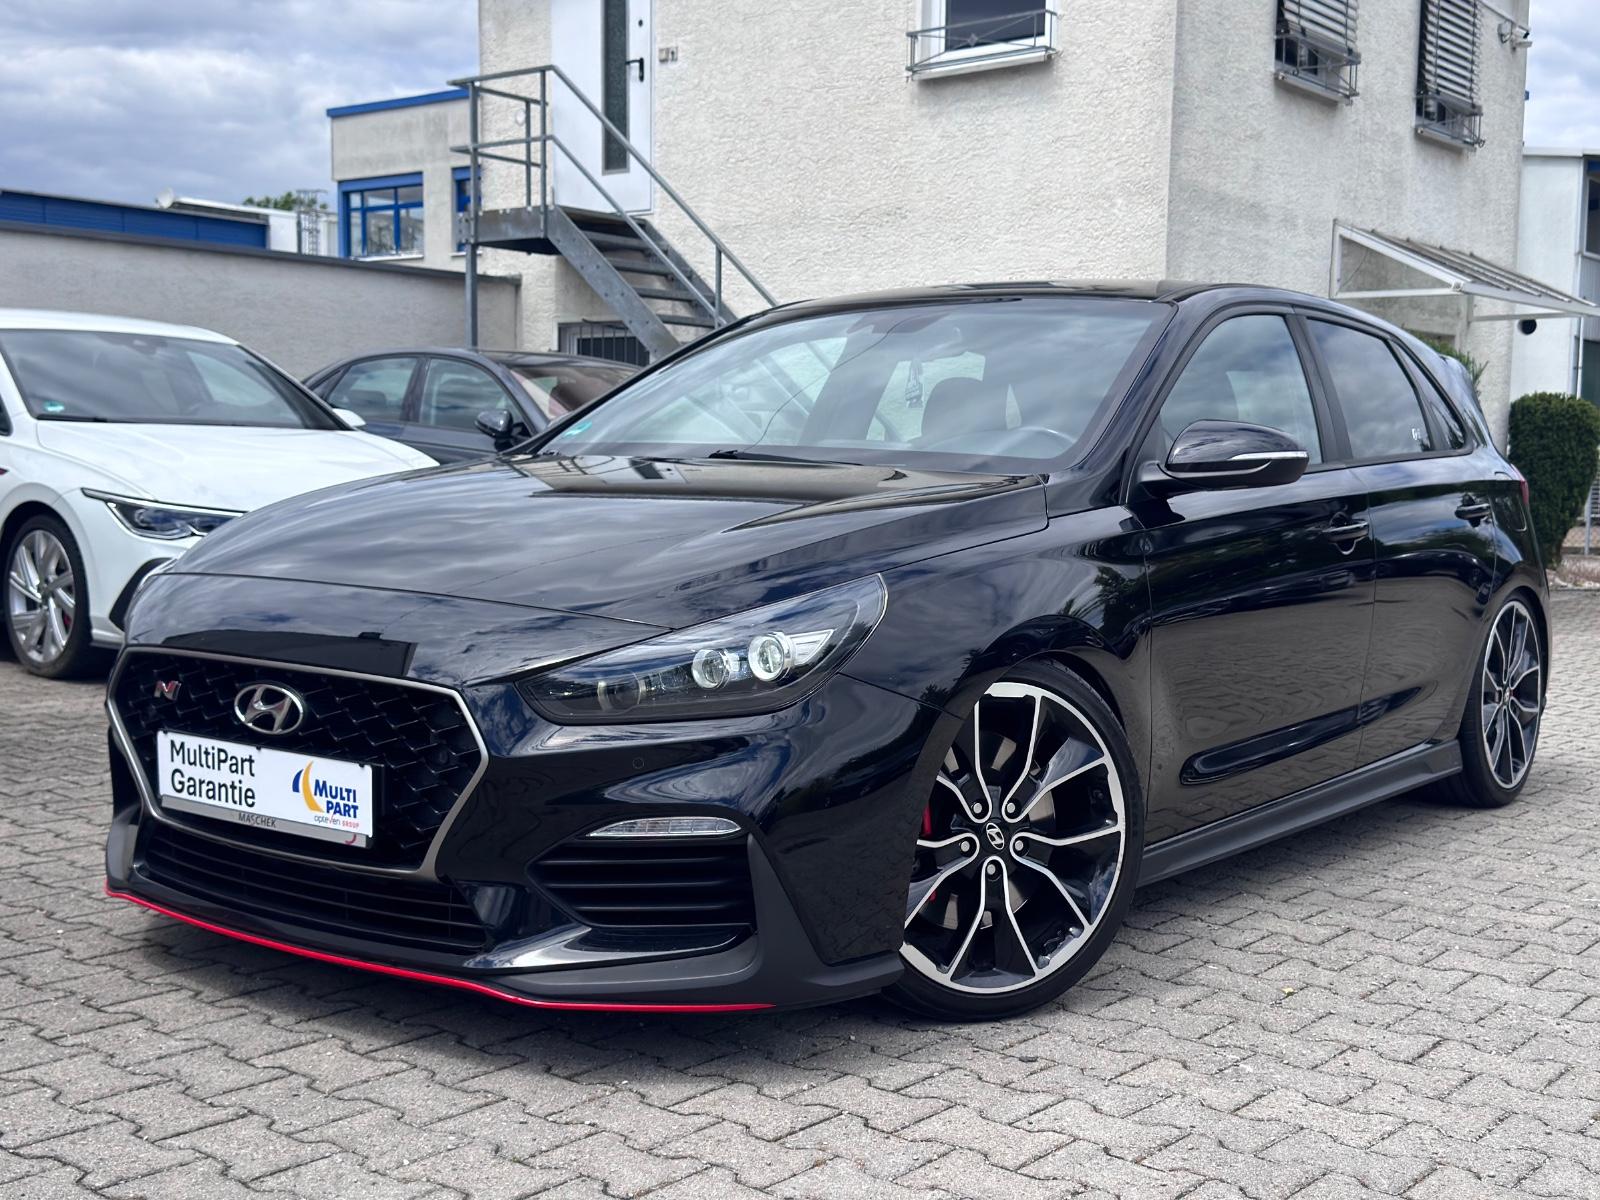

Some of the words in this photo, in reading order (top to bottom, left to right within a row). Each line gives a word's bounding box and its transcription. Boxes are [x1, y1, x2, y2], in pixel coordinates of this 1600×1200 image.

[170, 739, 255, 777] MultiPart
[171, 768, 256, 808] Garantie
[314, 779, 357, 803] MULTI
[239, 812, 276, 828] MASCHEK
[326, 800, 359, 819] PART
